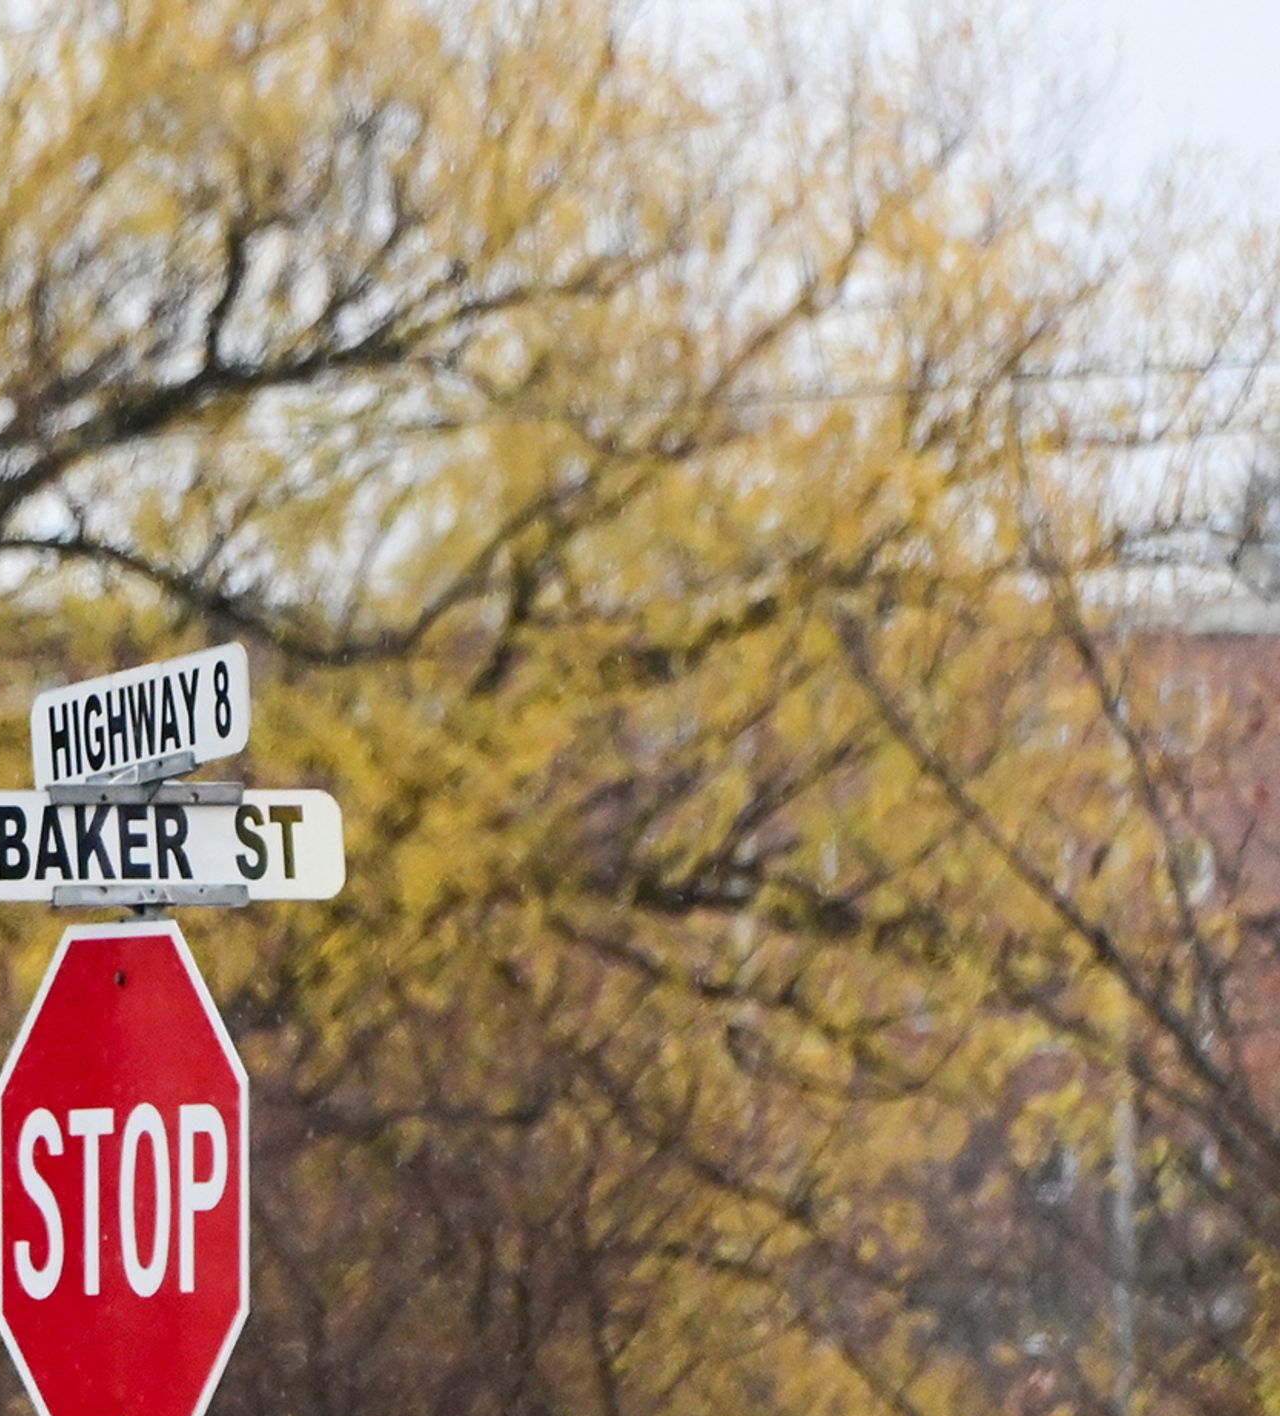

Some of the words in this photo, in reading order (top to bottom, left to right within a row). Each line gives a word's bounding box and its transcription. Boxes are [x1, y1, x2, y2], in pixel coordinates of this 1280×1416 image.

[48, 667, 200, 781] HIGHWAY
[213, 660, 232, 739] 8
[234, 803, 304, 880] ST
[13, 1102, 229, 1300] STOP
